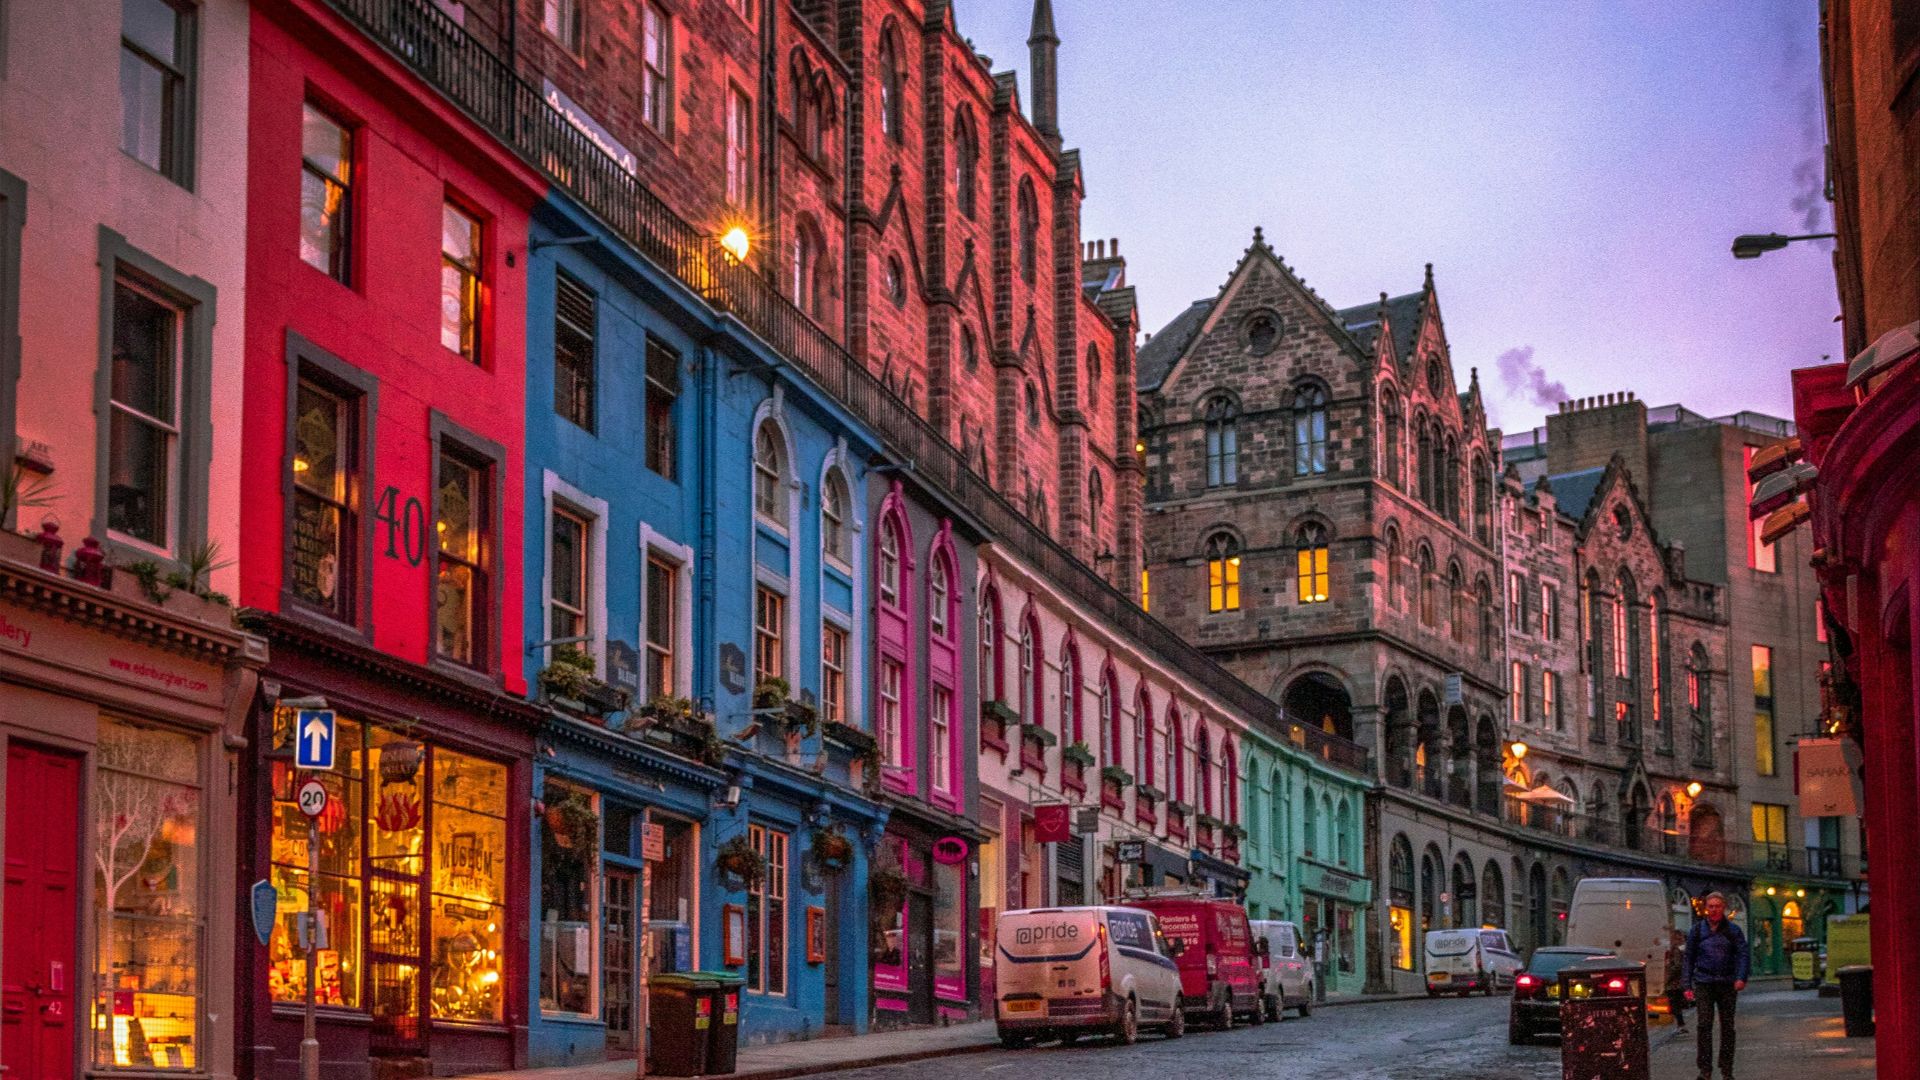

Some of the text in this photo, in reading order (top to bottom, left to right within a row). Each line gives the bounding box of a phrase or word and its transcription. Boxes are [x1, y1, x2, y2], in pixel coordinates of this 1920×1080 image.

[374, 485, 425, 569] 40
[302, 791, 324, 807] 20
[1033, 921, 1079, 944] pride
[48, 1001, 63, 1016] 42
